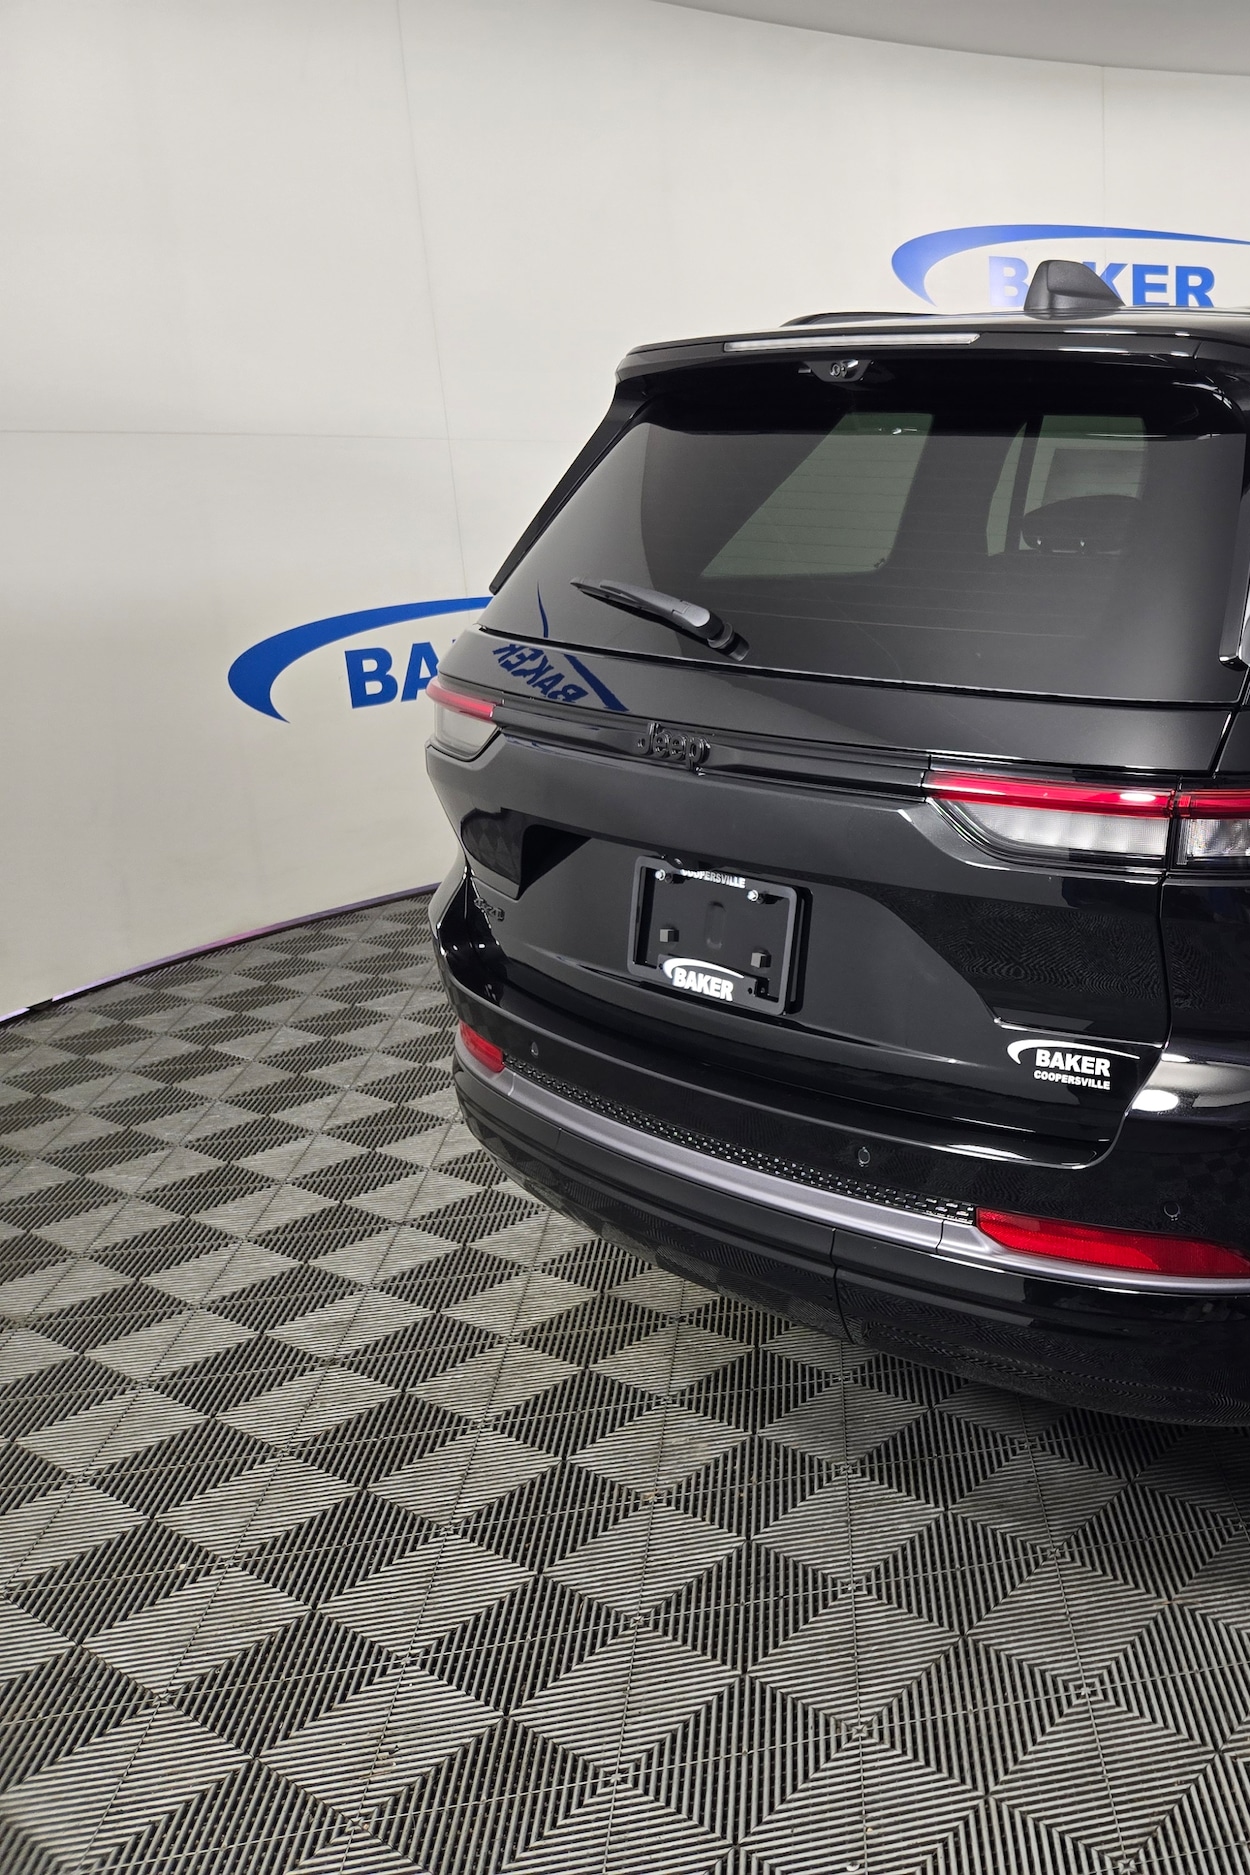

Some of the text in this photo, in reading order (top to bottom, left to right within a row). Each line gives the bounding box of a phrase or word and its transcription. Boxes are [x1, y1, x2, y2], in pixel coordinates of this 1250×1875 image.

[988, 255, 1215, 309] BKER
[344, 638, 457, 709] BA
[637, 722, 711, 776] Jeep
[672, 967, 734, 1002] BAKER
[1033, 1070, 1111, 1090] COOPERSVILLE
[1035, 1049, 1111, 1077] BAKER
